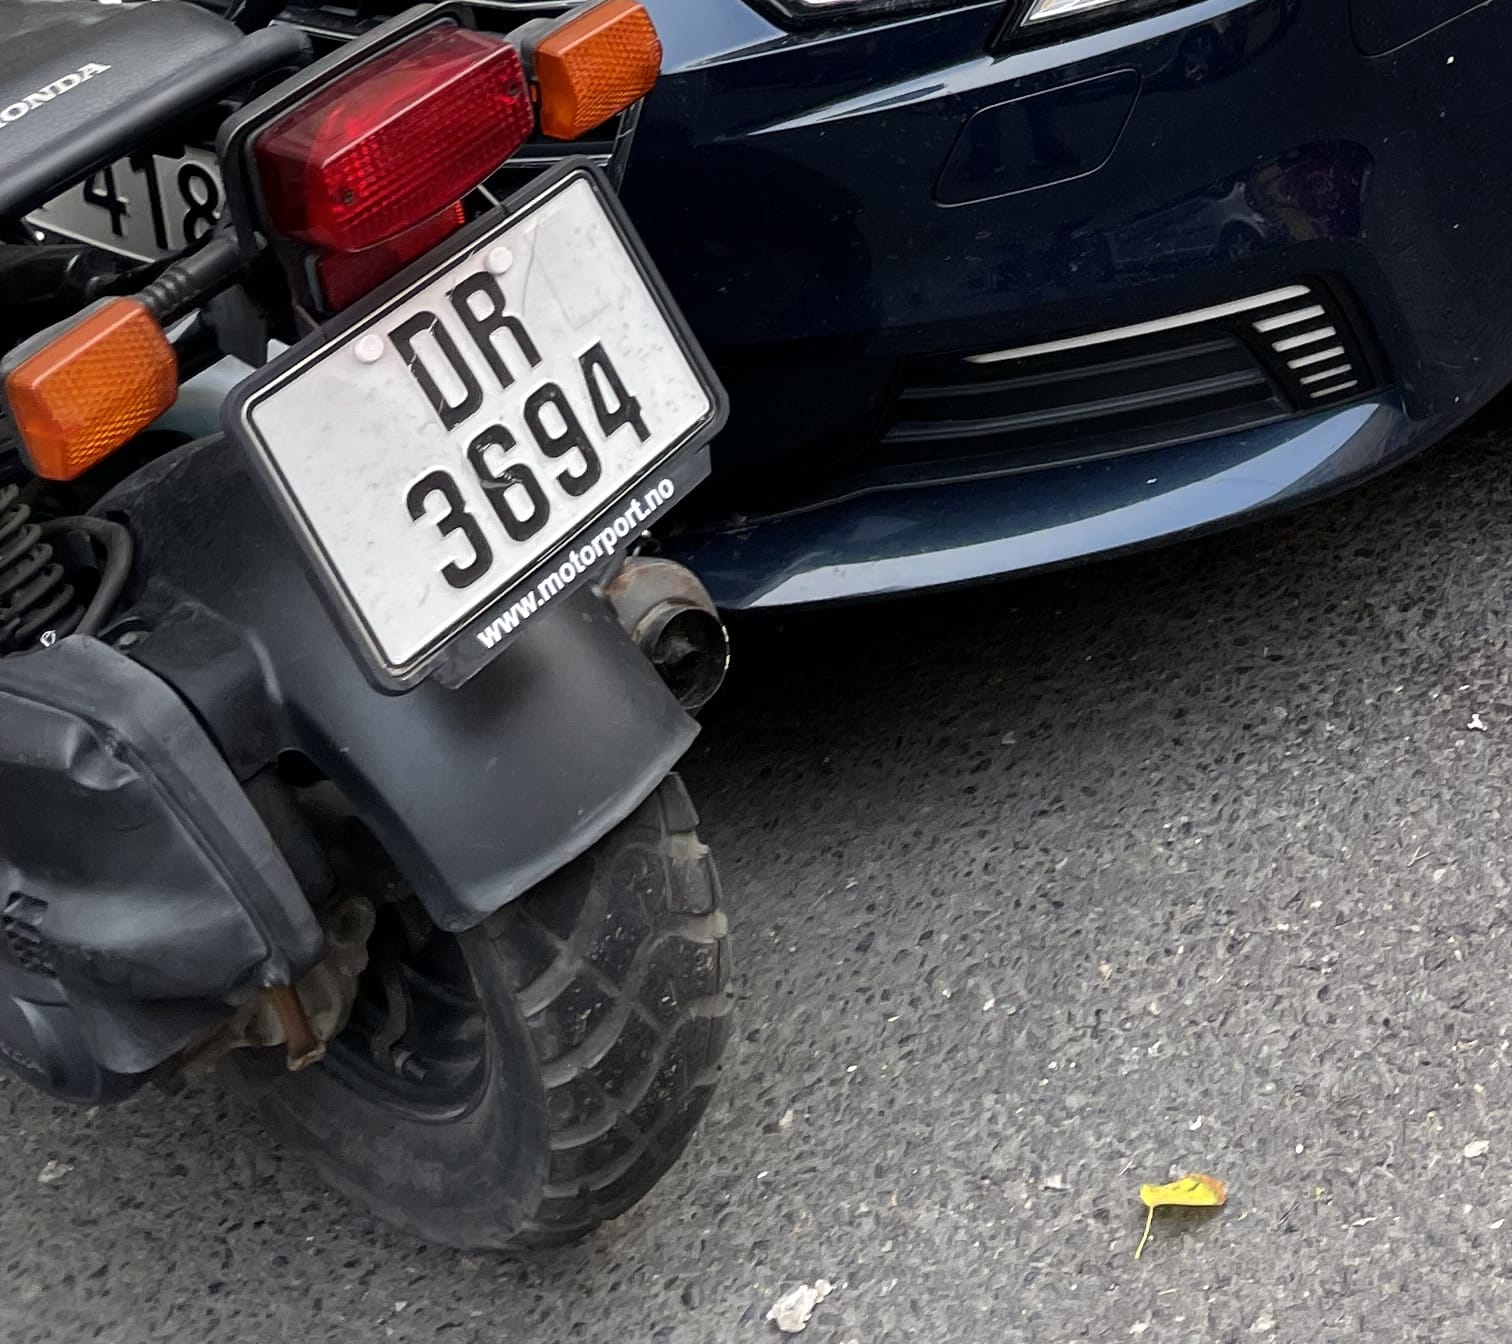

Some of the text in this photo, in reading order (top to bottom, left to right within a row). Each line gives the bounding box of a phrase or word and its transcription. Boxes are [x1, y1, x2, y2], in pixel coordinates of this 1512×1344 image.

[0, 62, 112, 129] ONDA
[387, 270, 543, 432] DR
[405, 340, 651, 589] 3694
[476, 478, 675, 649] www.motorport.no
